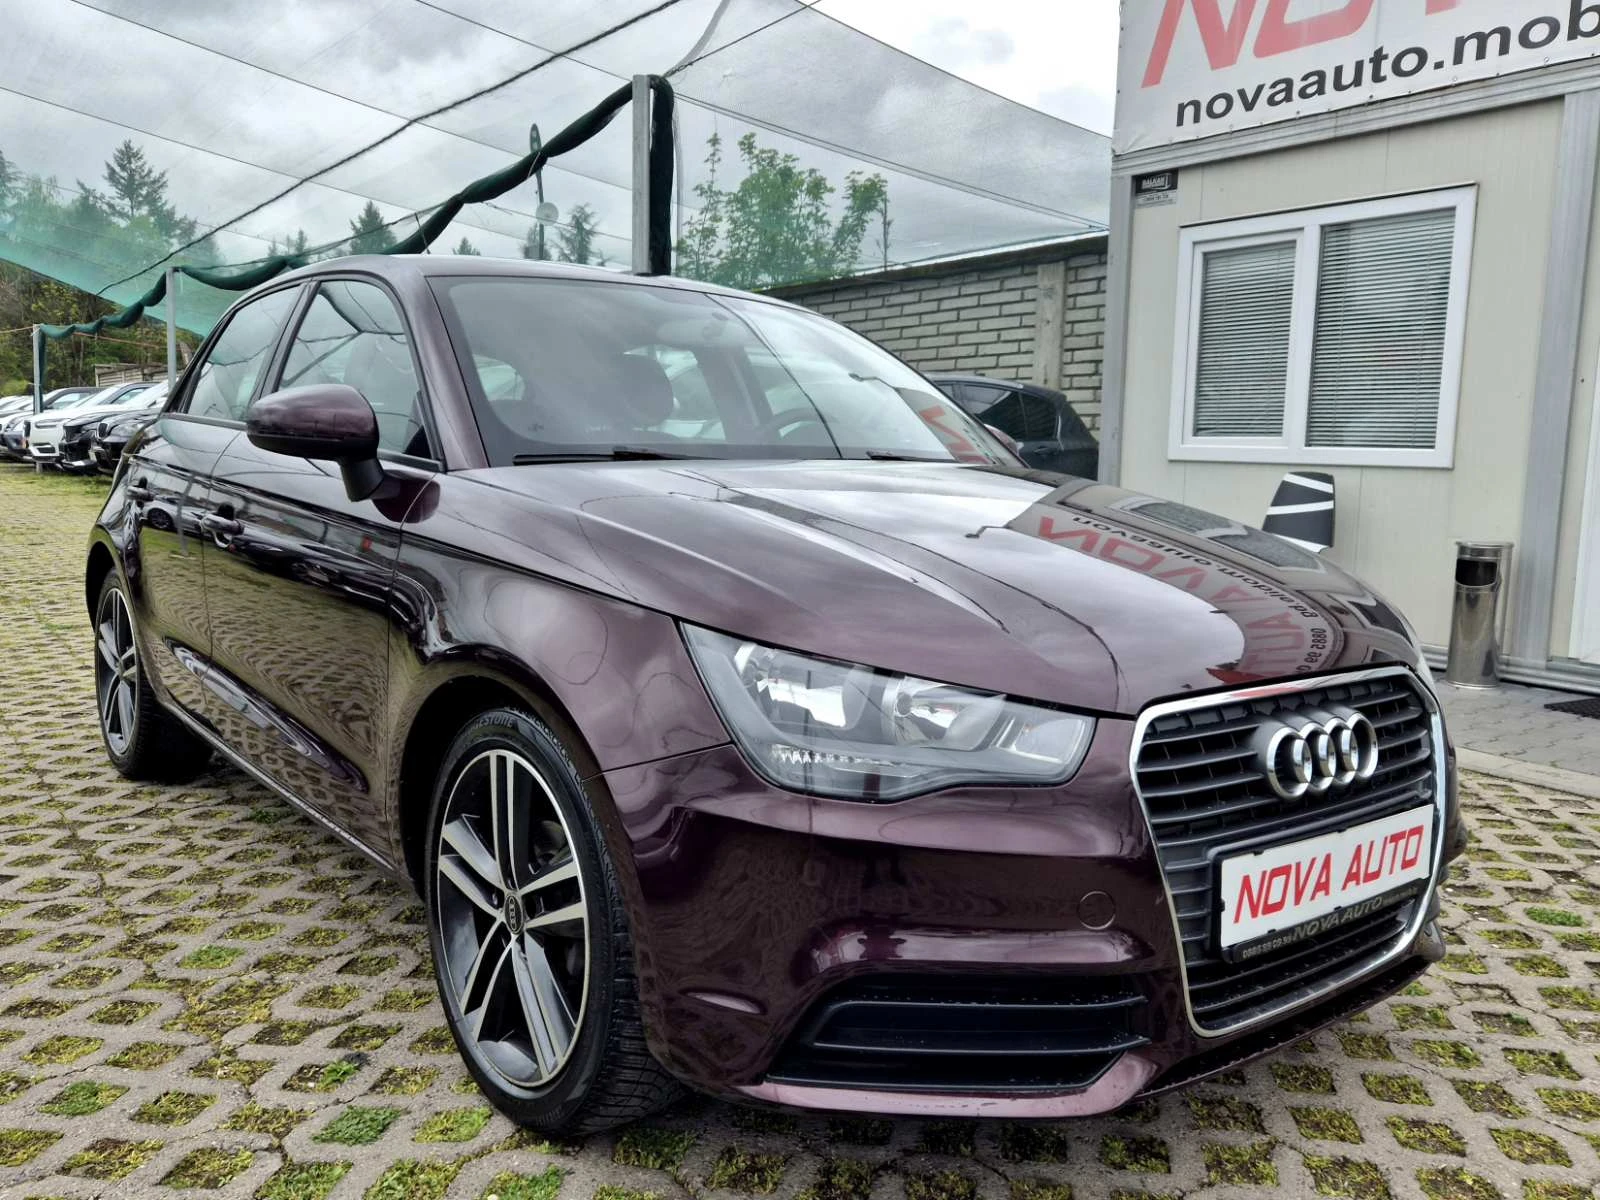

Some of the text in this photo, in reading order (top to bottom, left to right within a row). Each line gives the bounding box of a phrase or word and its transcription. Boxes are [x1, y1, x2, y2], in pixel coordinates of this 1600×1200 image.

[1233, 824, 1425, 924] NOVA AUTO
[1293, 914, 1340, 941] NOVA
[1341, 897, 1382, 922] AUTO
